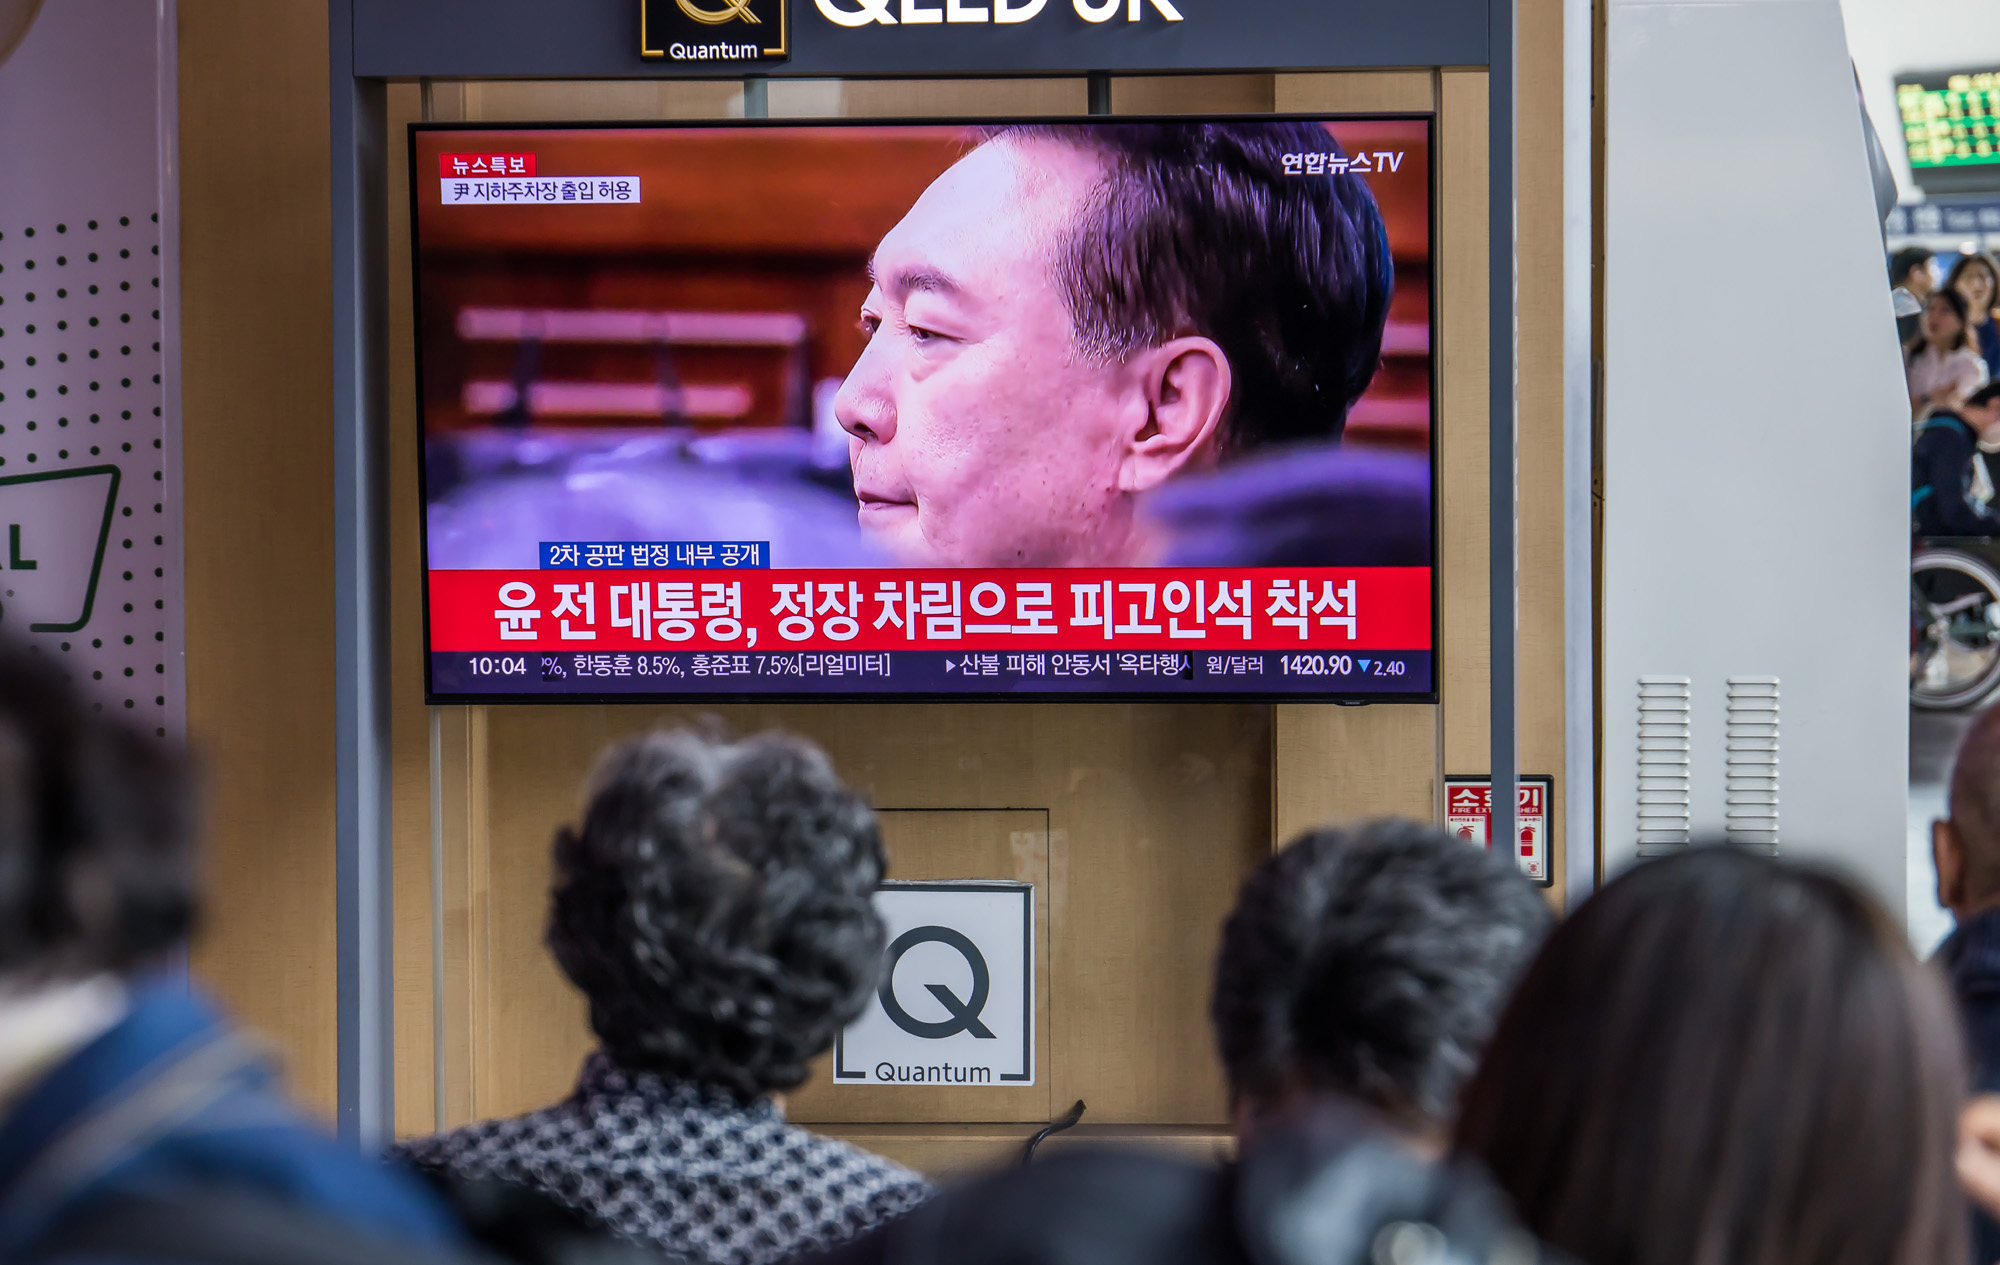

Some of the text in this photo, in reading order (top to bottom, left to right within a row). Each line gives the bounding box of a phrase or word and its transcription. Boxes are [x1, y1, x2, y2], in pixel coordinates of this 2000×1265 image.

[670, 41, 758, 60] Quantum
[453, 156, 526, 175] 뉴스특보
[1281, 151, 1405, 175] 연합뉴스TV
[453, 180, 632, 201] 尹 지하주차장 출입 허용
[0, 523, 38, 570] L
[550, 543, 760, 567] 2차 공판 법정 내부 공개
[494, 580, 1357, 648] 윤 전 대통령, 정장 차림으로 피고인석 착석
[469, 656, 527, 675] 10:04
[573, 654, 633, 677] 한동훈
[637, 655, 685, 678] 8.5%,
[691, 654, 751, 676] 홍준표
[959, 653, 1000, 676] 산불
[1006, 653, 1045, 676] 피해
[1051, 653, 1110, 676] 안동서
[1206, 655, 1406, 676] 원/달러 1420.90 2.40
[1452, 788, 1539, 807] 소기
[877, 925, 998, 1040] Q
[875, 1061, 991, 1083] Quantum
